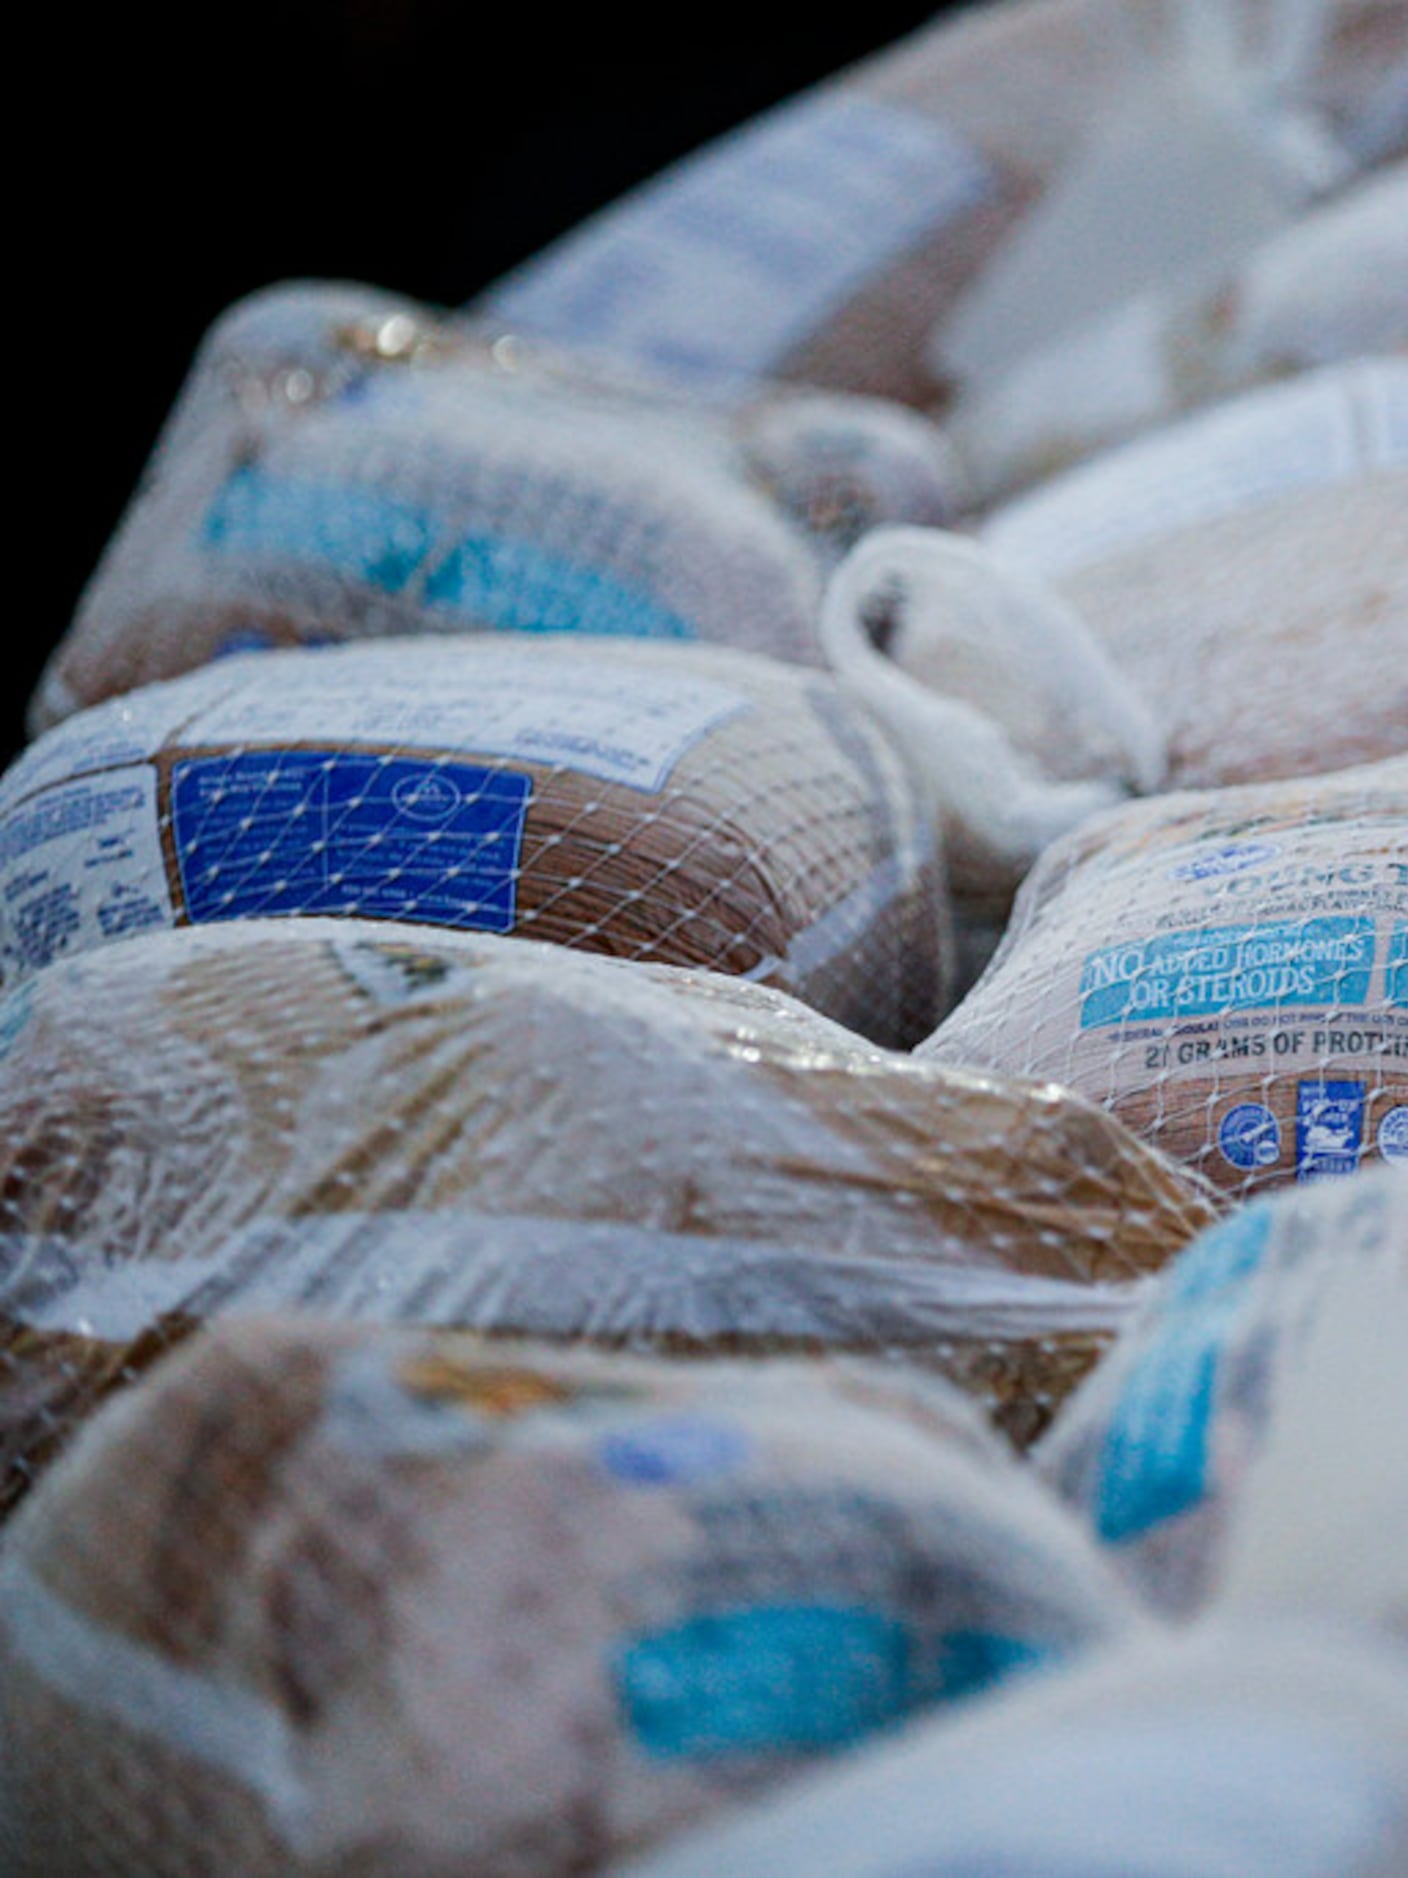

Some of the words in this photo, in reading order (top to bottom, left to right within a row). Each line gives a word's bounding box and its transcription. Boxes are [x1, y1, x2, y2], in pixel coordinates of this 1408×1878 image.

[1092, 949, 1144, 988] NO
[1149, 946, 1229, 976] ADDED
[1236, 938, 1365, 967] HORMONES
[1131, 978, 1170, 1009] OR
[1174, 965, 1316, 1006] STEROIDS
[1177, 1034, 1266, 1066] GRAMS
[1272, 1031, 1306, 1055] OF
